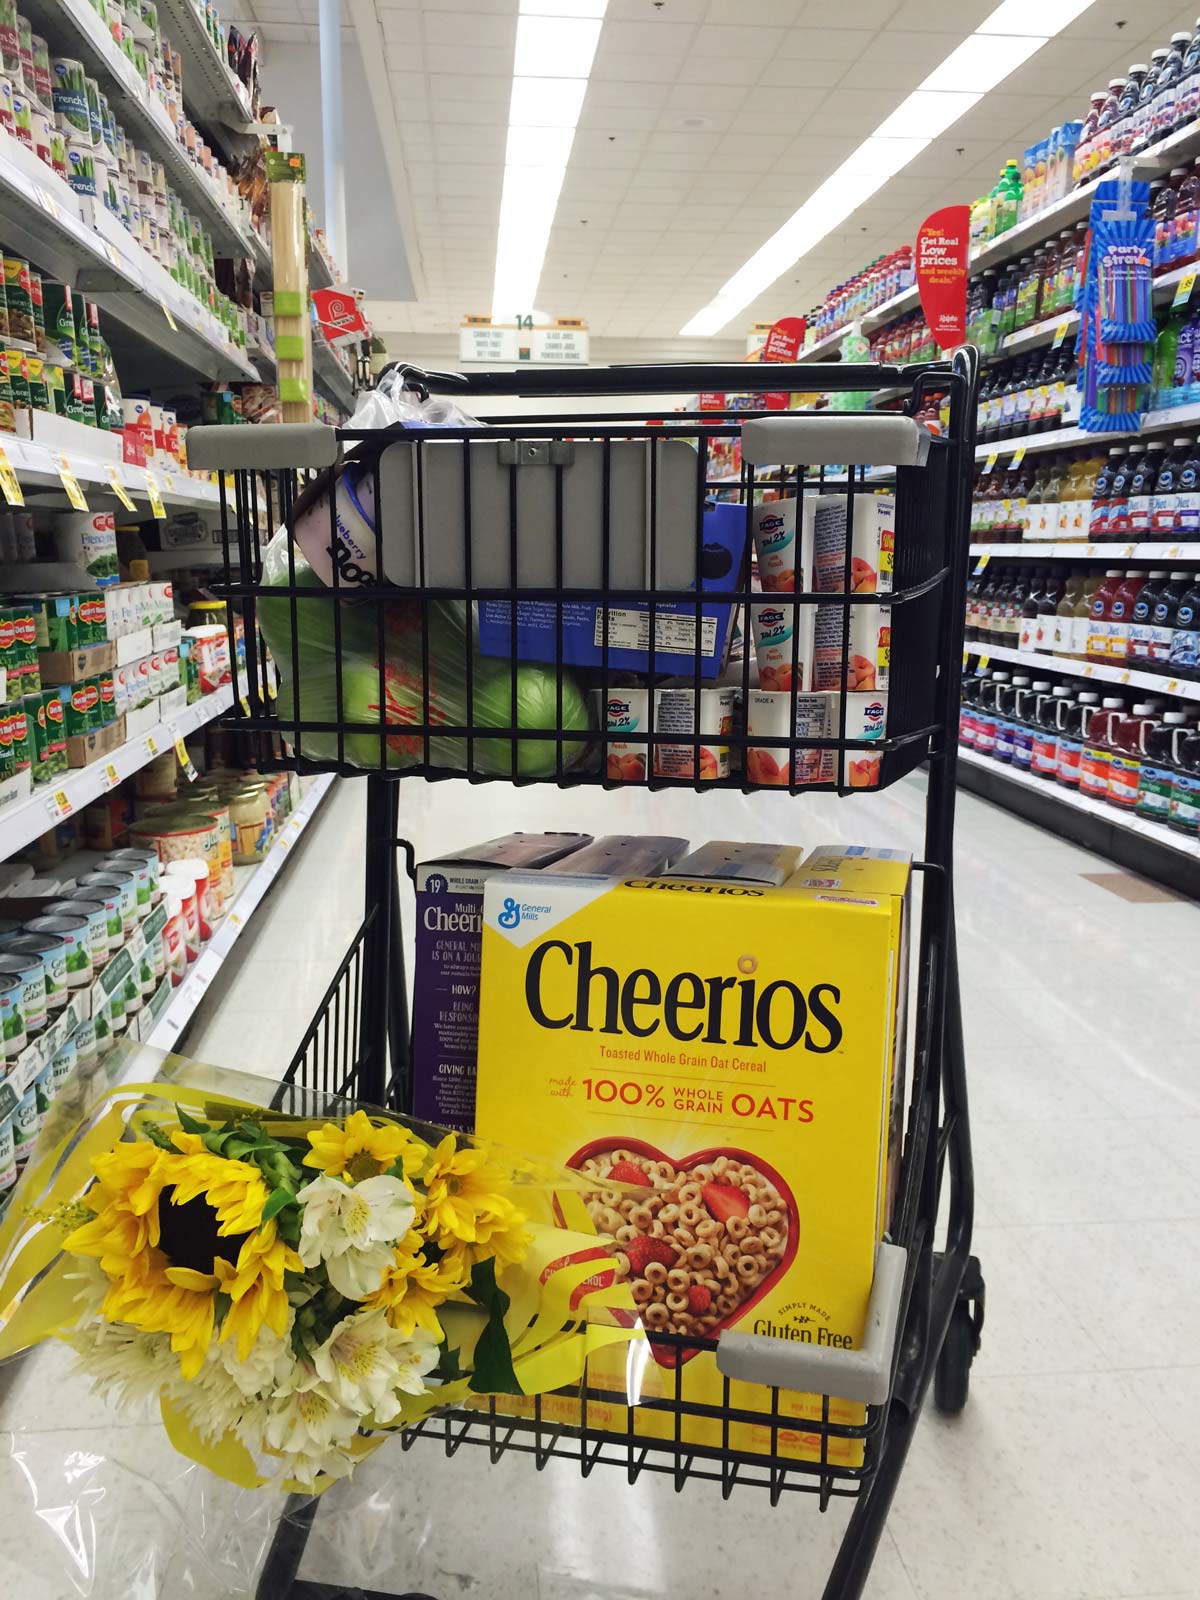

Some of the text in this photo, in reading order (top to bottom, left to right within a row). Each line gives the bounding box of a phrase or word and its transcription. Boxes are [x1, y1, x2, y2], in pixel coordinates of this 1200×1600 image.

[920, 237, 959, 246] Get Real
[920, 245, 947, 255] Low
[1107, 245, 1147, 256] Party
[920, 256, 958, 267] prices
[516, 314, 534, 331] 14
[335, 513, 367, 560] lueberry
[773, 530, 786, 542] 2%
[596, 609, 627, 618] Nrition
[772, 625, 785, 637] 2%
[608, 704, 628, 712] AGE
[617, 717, 631, 727] 2%
[623, 878, 766, 898] Cheerios
[455, 902, 476, 913] Multi
[521, 903, 552, 914] General
[521, 912, 539, 921] Mills
[451, 984, 477, 996] HOW?
[525, 939, 844, 1055] Cheerios
[599, 1045, 767, 1073] Toasted Whole Grain Oat Cereal
[438, 1064, 465, 1075] GIVING
[549, 1076, 578, 1087] made
[550, 1087, 573, 1098] with
[582, 1078, 665, 1109] 100%
[673, 1087, 724, 1101] WHOLE
[673, 1098, 723, 1114] GRAIN
[731, 1093, 815, 1123] OATS
[778, 1302, 807, 1315] SIMPLY
[809, 1304, 831, 1321] MADE
[753, 1319, 812, 1344] Gluten
[817, 1327, 853, 1350] Free
